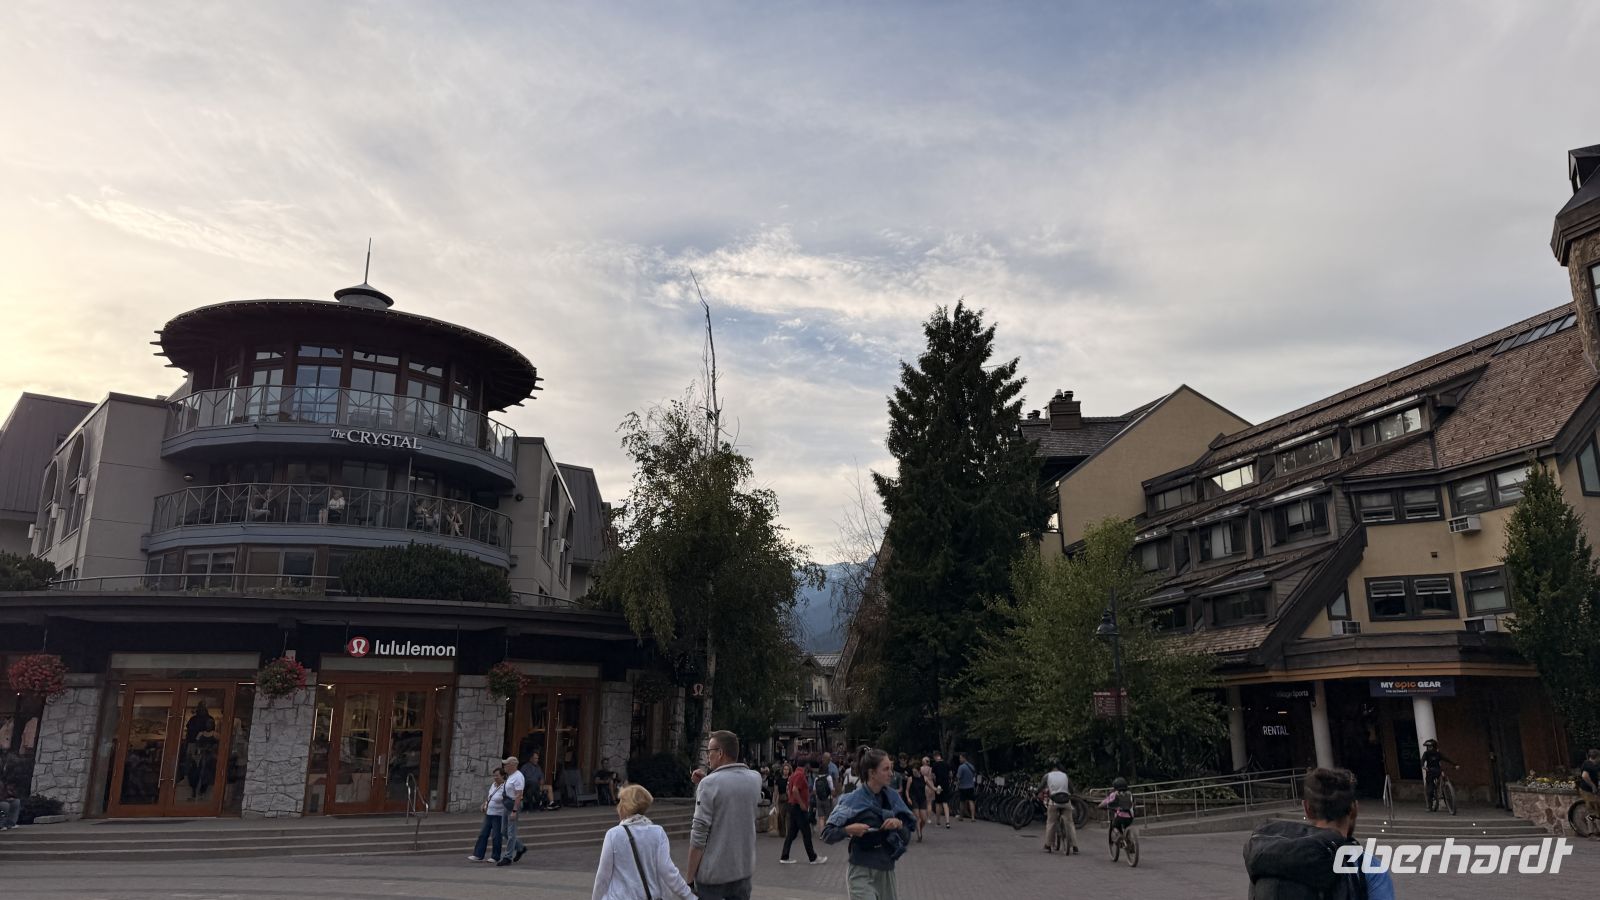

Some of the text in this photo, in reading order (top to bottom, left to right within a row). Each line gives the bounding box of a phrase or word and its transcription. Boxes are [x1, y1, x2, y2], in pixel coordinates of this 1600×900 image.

[330, 428, 423, 450] The CRYSTAL
[374, 639, 456, 657] lululemon
[1380, 681, 1394, 689] MY
[1394, 681, 1416, 690] epic
[1262, 725, 1291, 736] RENTAL
